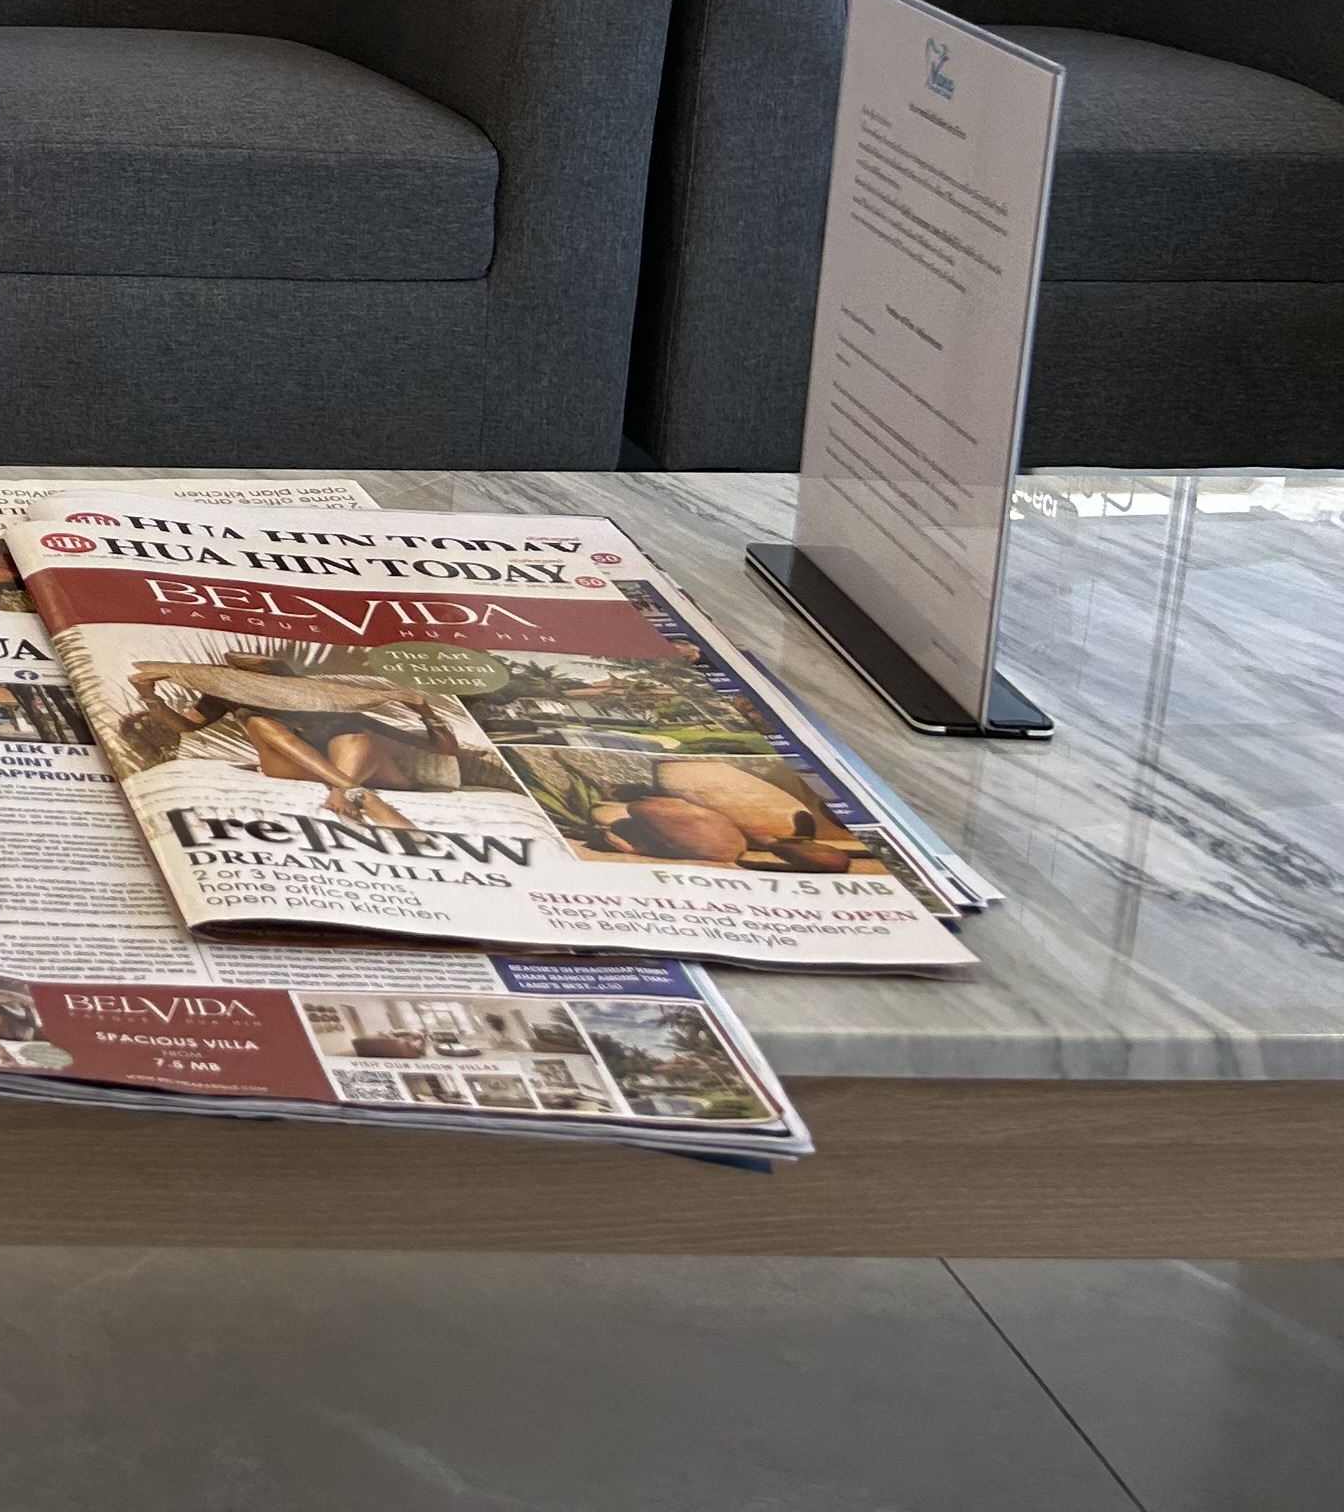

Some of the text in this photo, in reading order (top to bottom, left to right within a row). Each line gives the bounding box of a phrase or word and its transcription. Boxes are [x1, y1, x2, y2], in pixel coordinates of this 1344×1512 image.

[99, 536, 237, 567] HUA
[239, 550, 362, 577] HIN
[368, 557, 571, 585] TODAY
[144, 577, 543, 636] BELVIDA
[382, 662, 495, 676] of Natural
[385, 650, 469, 662] The Art
[414, 674, 487, 688] Living
[4, 743, 47, 755] LEK
[51, 745, 90, 757] FAI
[184, 850, 513, 888] DREAM VILLAS
[192, 869, 210, 881] 2
[215, 869, 243, 880] or
[249, 868, 267, 881] 3
[651, 869, 752, 892] From
[832, 879, 896, 897] MB
[197, 881, 422, 907] home office and
[206, 893, 452, 922] open plan kitchen
[528, 890, 919, 923] SHOW VILLAS NOW OPEN
[536, 903, 892, 938] Step inside and experience
[549, 917, 799, 948] the BelVida lifestyle
[64, 994, 256, 1024] BELVIDA
[95, 1031, 260, 1051] SPACIOUS VILLA
[190, 1061, 223, 1072] MB
